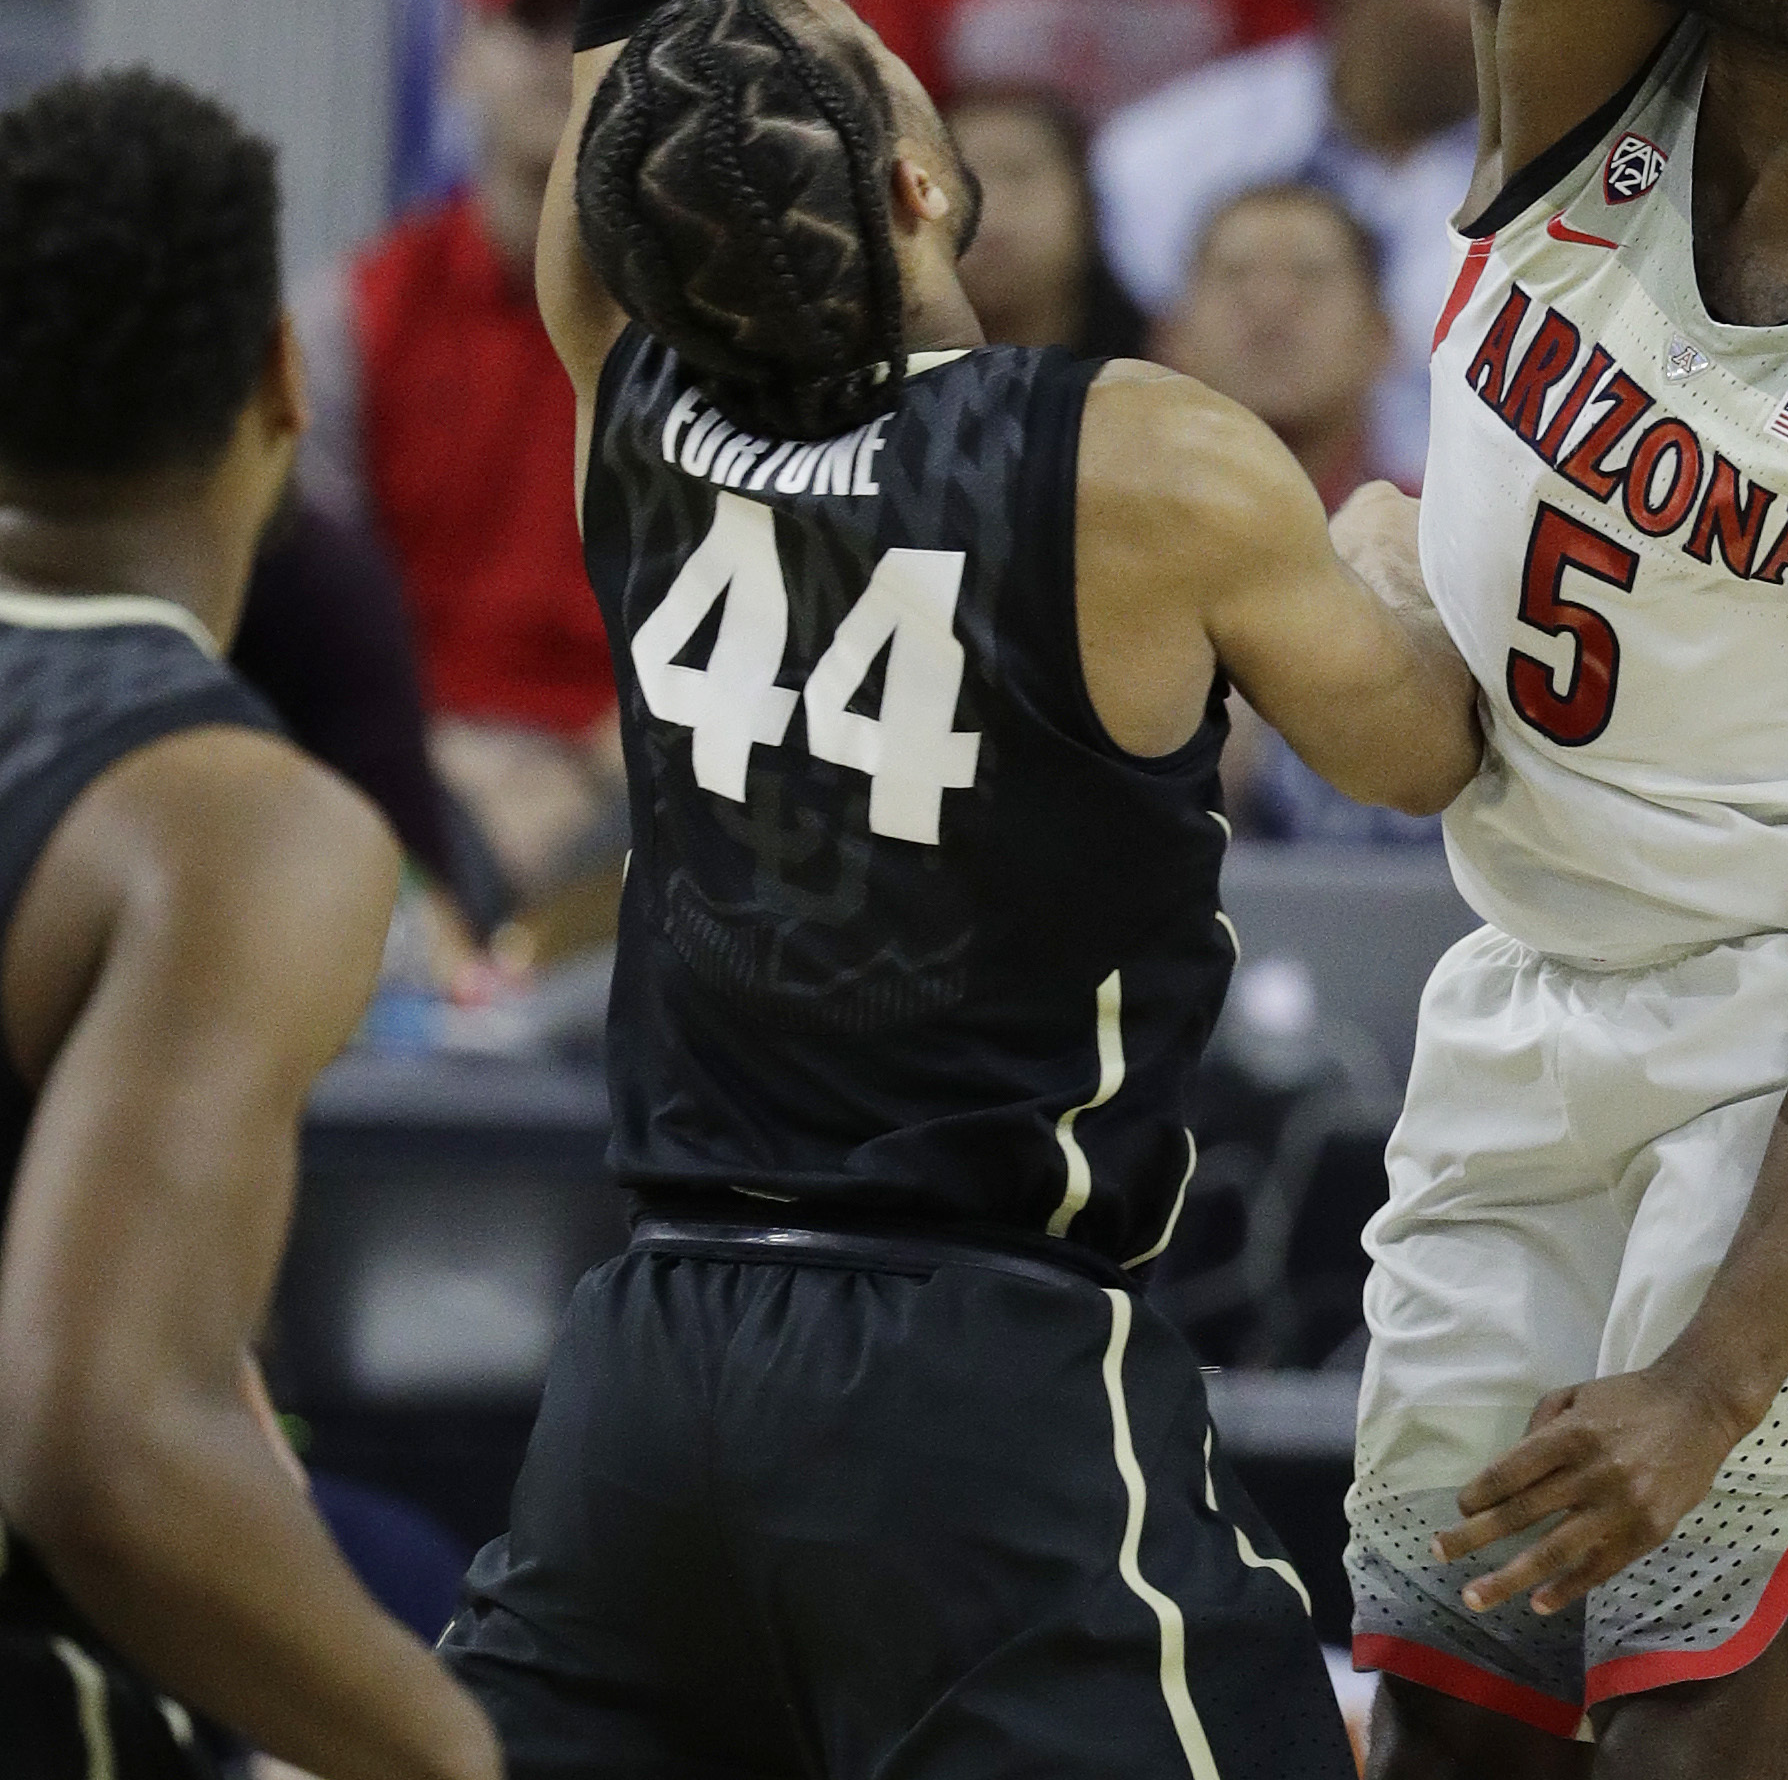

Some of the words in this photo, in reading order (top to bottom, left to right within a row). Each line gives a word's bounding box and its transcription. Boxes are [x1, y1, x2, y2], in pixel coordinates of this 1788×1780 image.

[1609, 164, 1642, 196] 12
[1611, 136, 1666, 190] PAC
[1671, 345, 1698, 373] A
[1506, 499, 1641, 748] 5
[631, 490, 982, 845] 44
